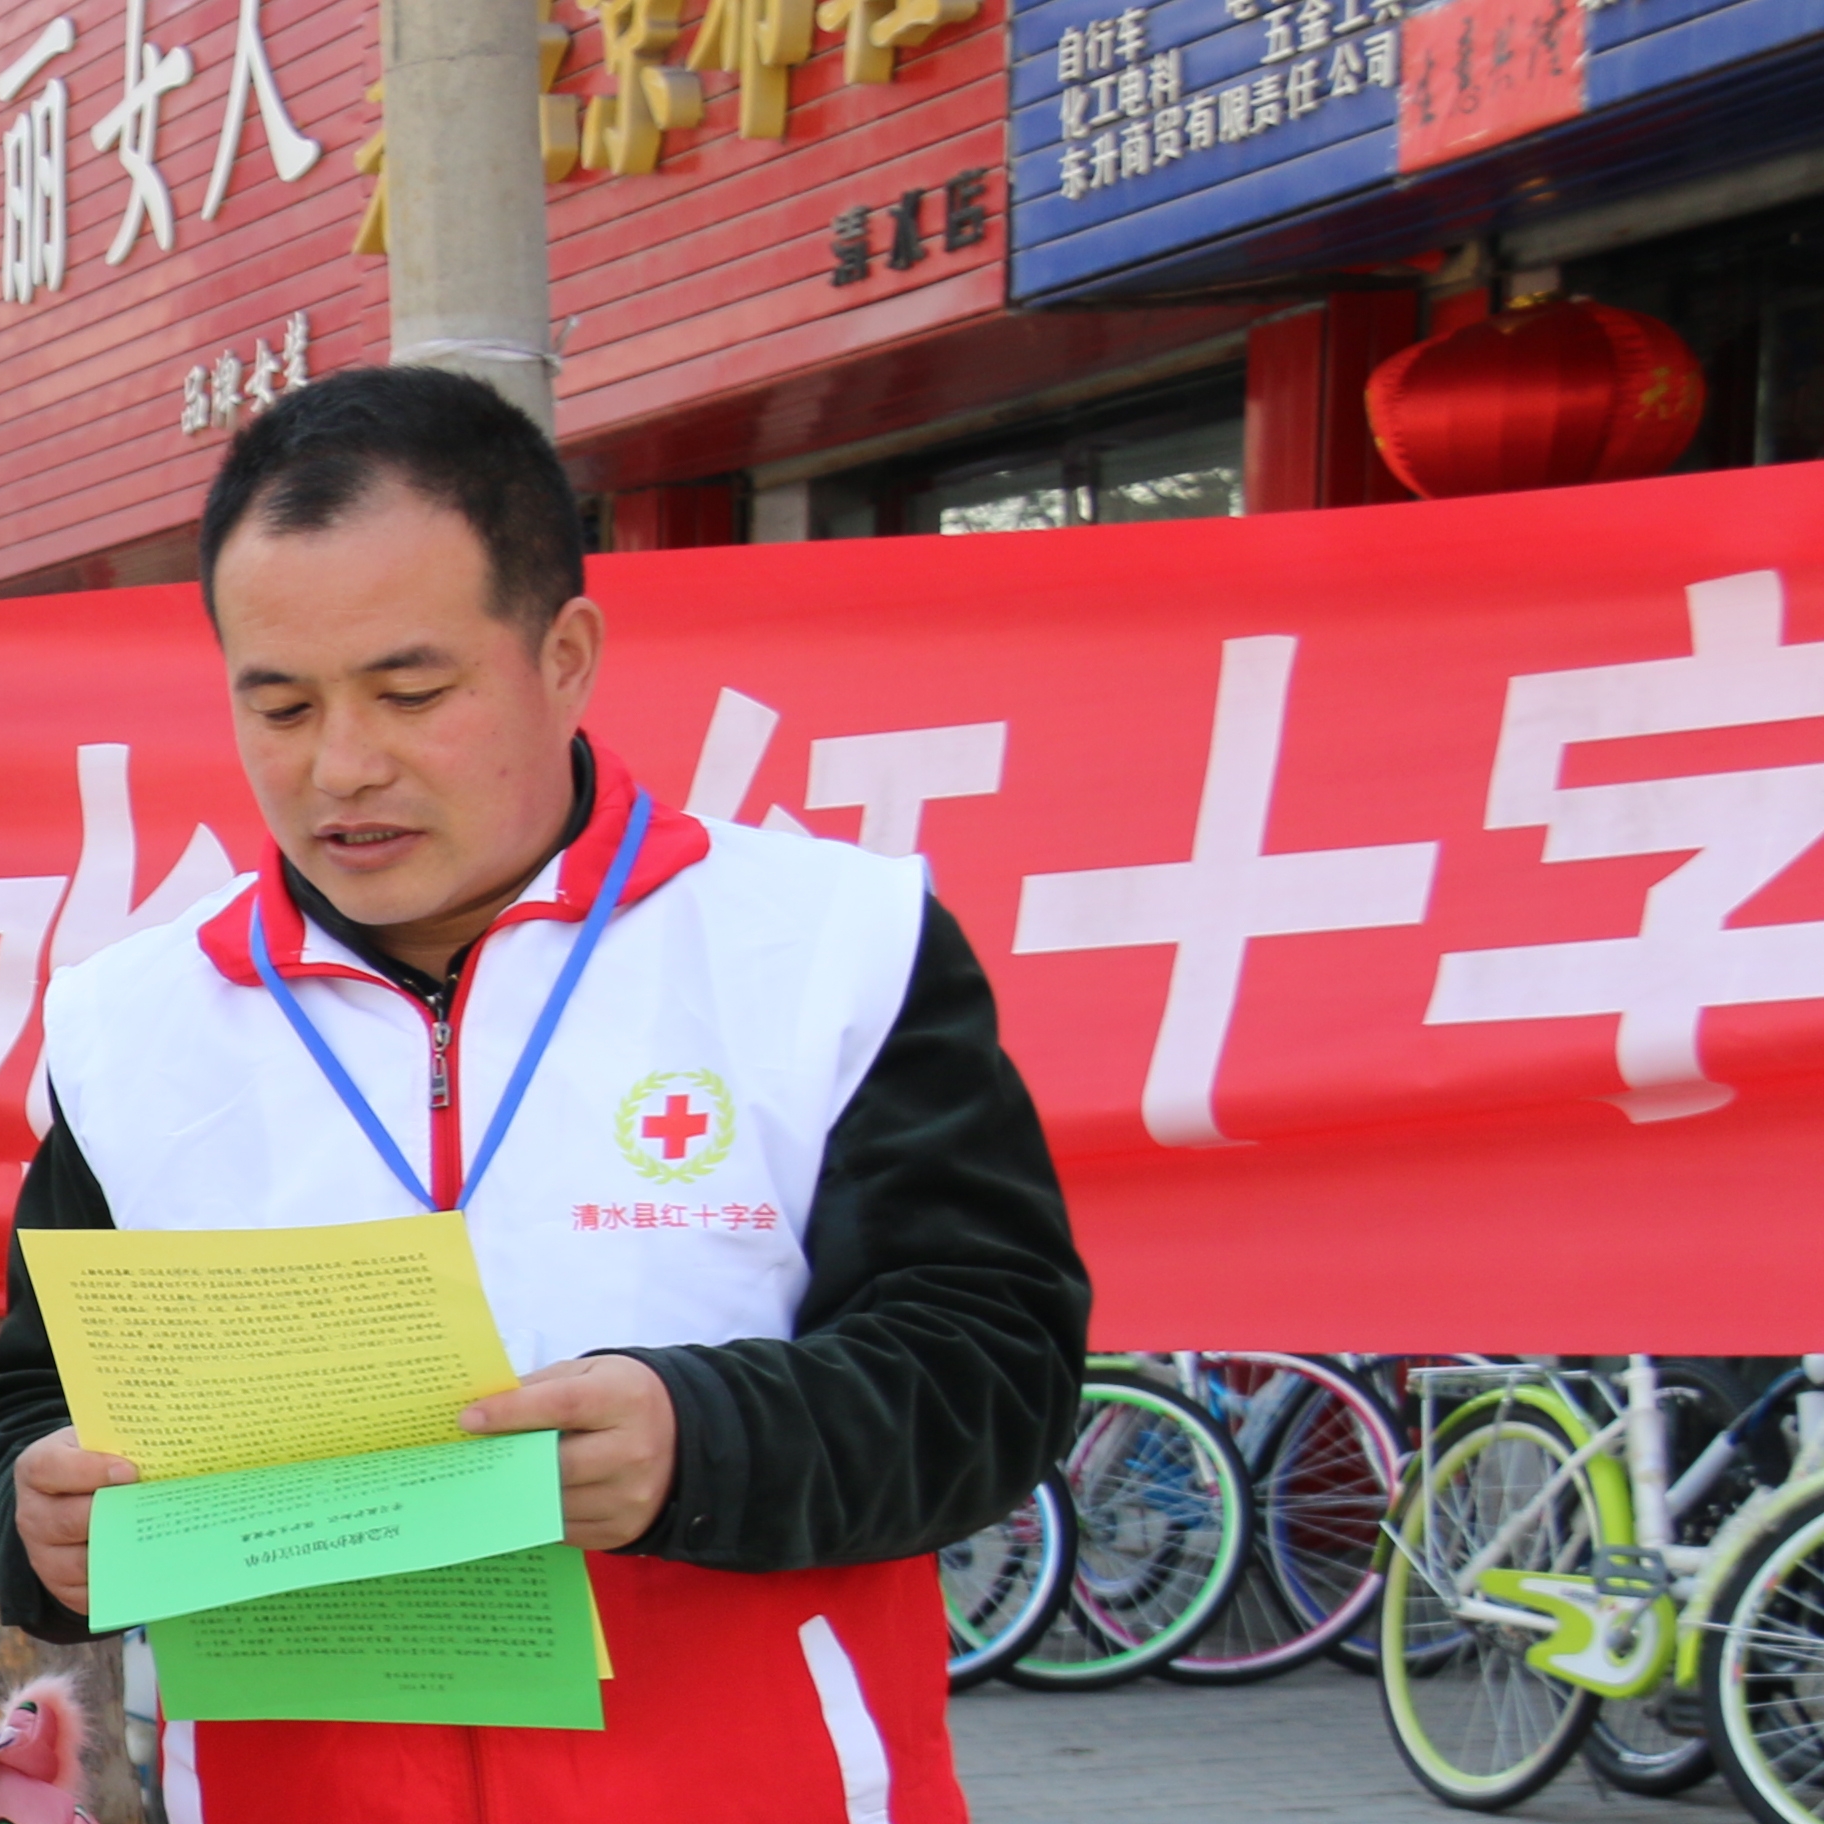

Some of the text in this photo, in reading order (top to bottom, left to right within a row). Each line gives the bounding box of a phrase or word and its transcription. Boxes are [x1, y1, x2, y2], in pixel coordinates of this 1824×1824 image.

[1057, 7, 1146, 82] 自行车
[1057, 47, 1184, 141] 化工电料
[1058, 25, 1399, 200] 东升商贸有限责任公司
[180, 310, 310, 436] 品牌女装
[571, 1202, 779, 1232] 清水县红十字会
